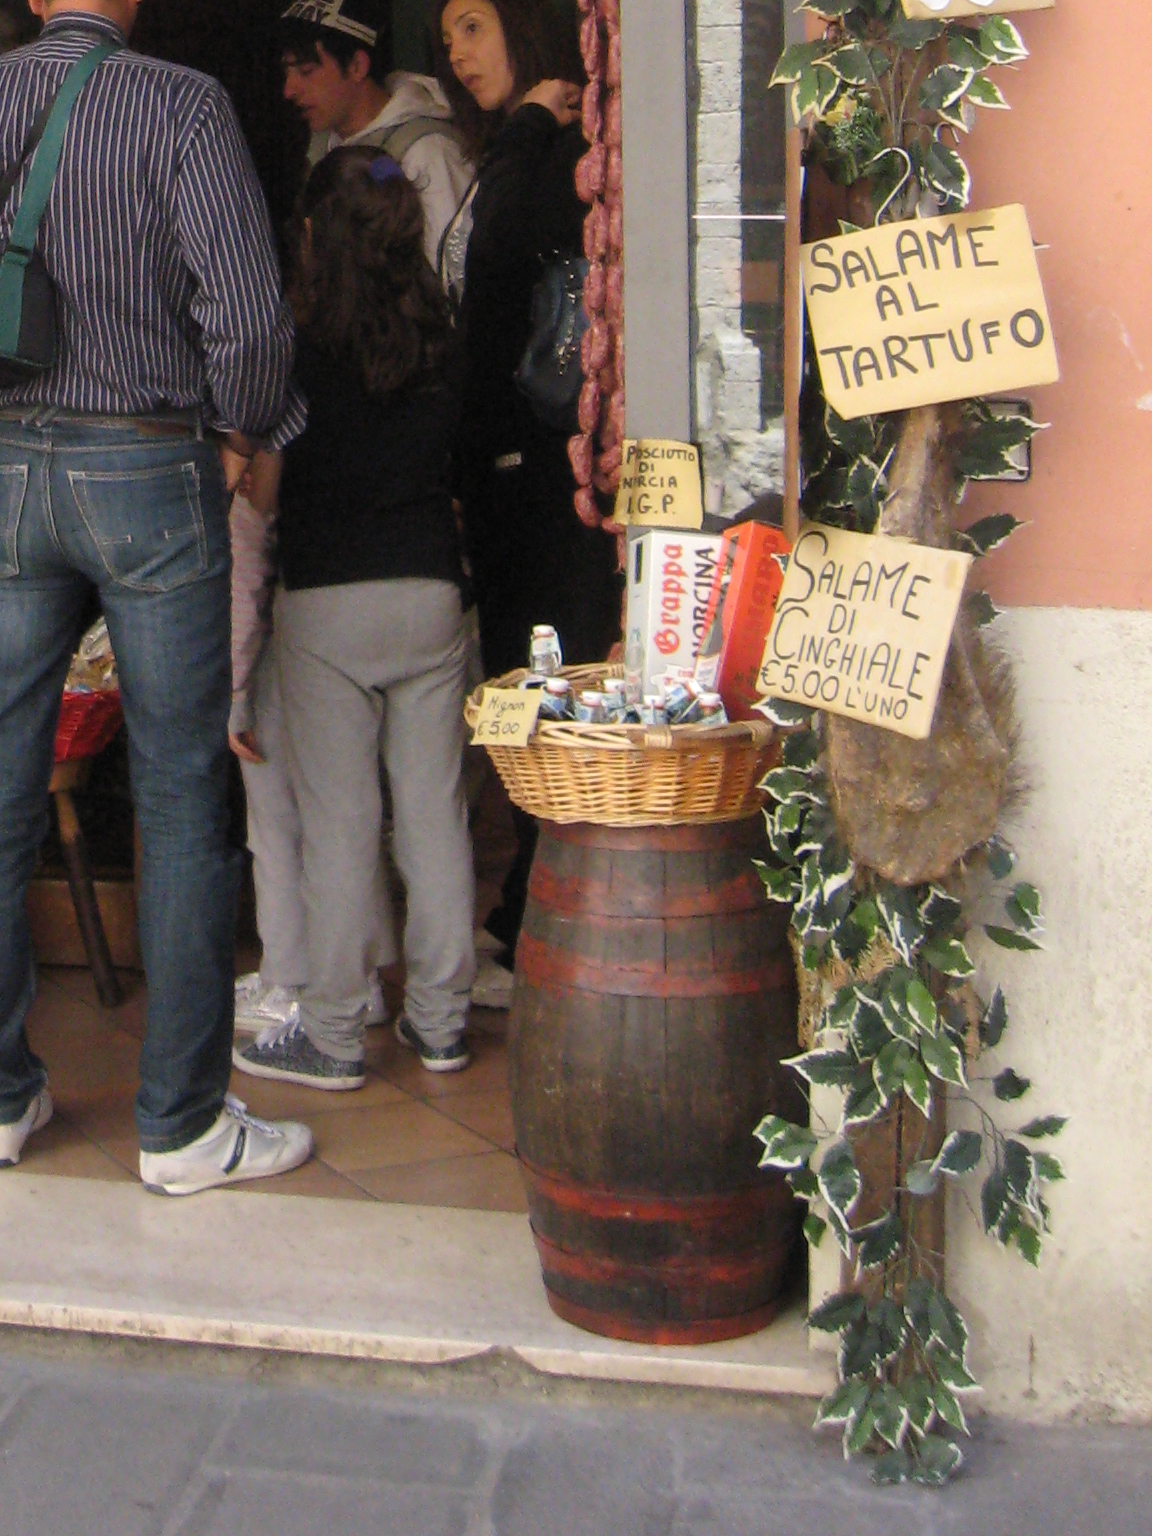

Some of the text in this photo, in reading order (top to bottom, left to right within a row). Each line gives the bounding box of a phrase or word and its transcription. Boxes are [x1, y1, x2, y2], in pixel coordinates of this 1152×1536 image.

[810, 223, 999, 296] SALAME
[875, 281, 939, 322] AL
[819, 308, 1045, 390] TARTUFO
[638, 461, 655, 473] DI
[776, 530, 931, 620] SALAME
[772, 606, 931, 700] CINGHIALE
[827, 603, 855, 635] DI
